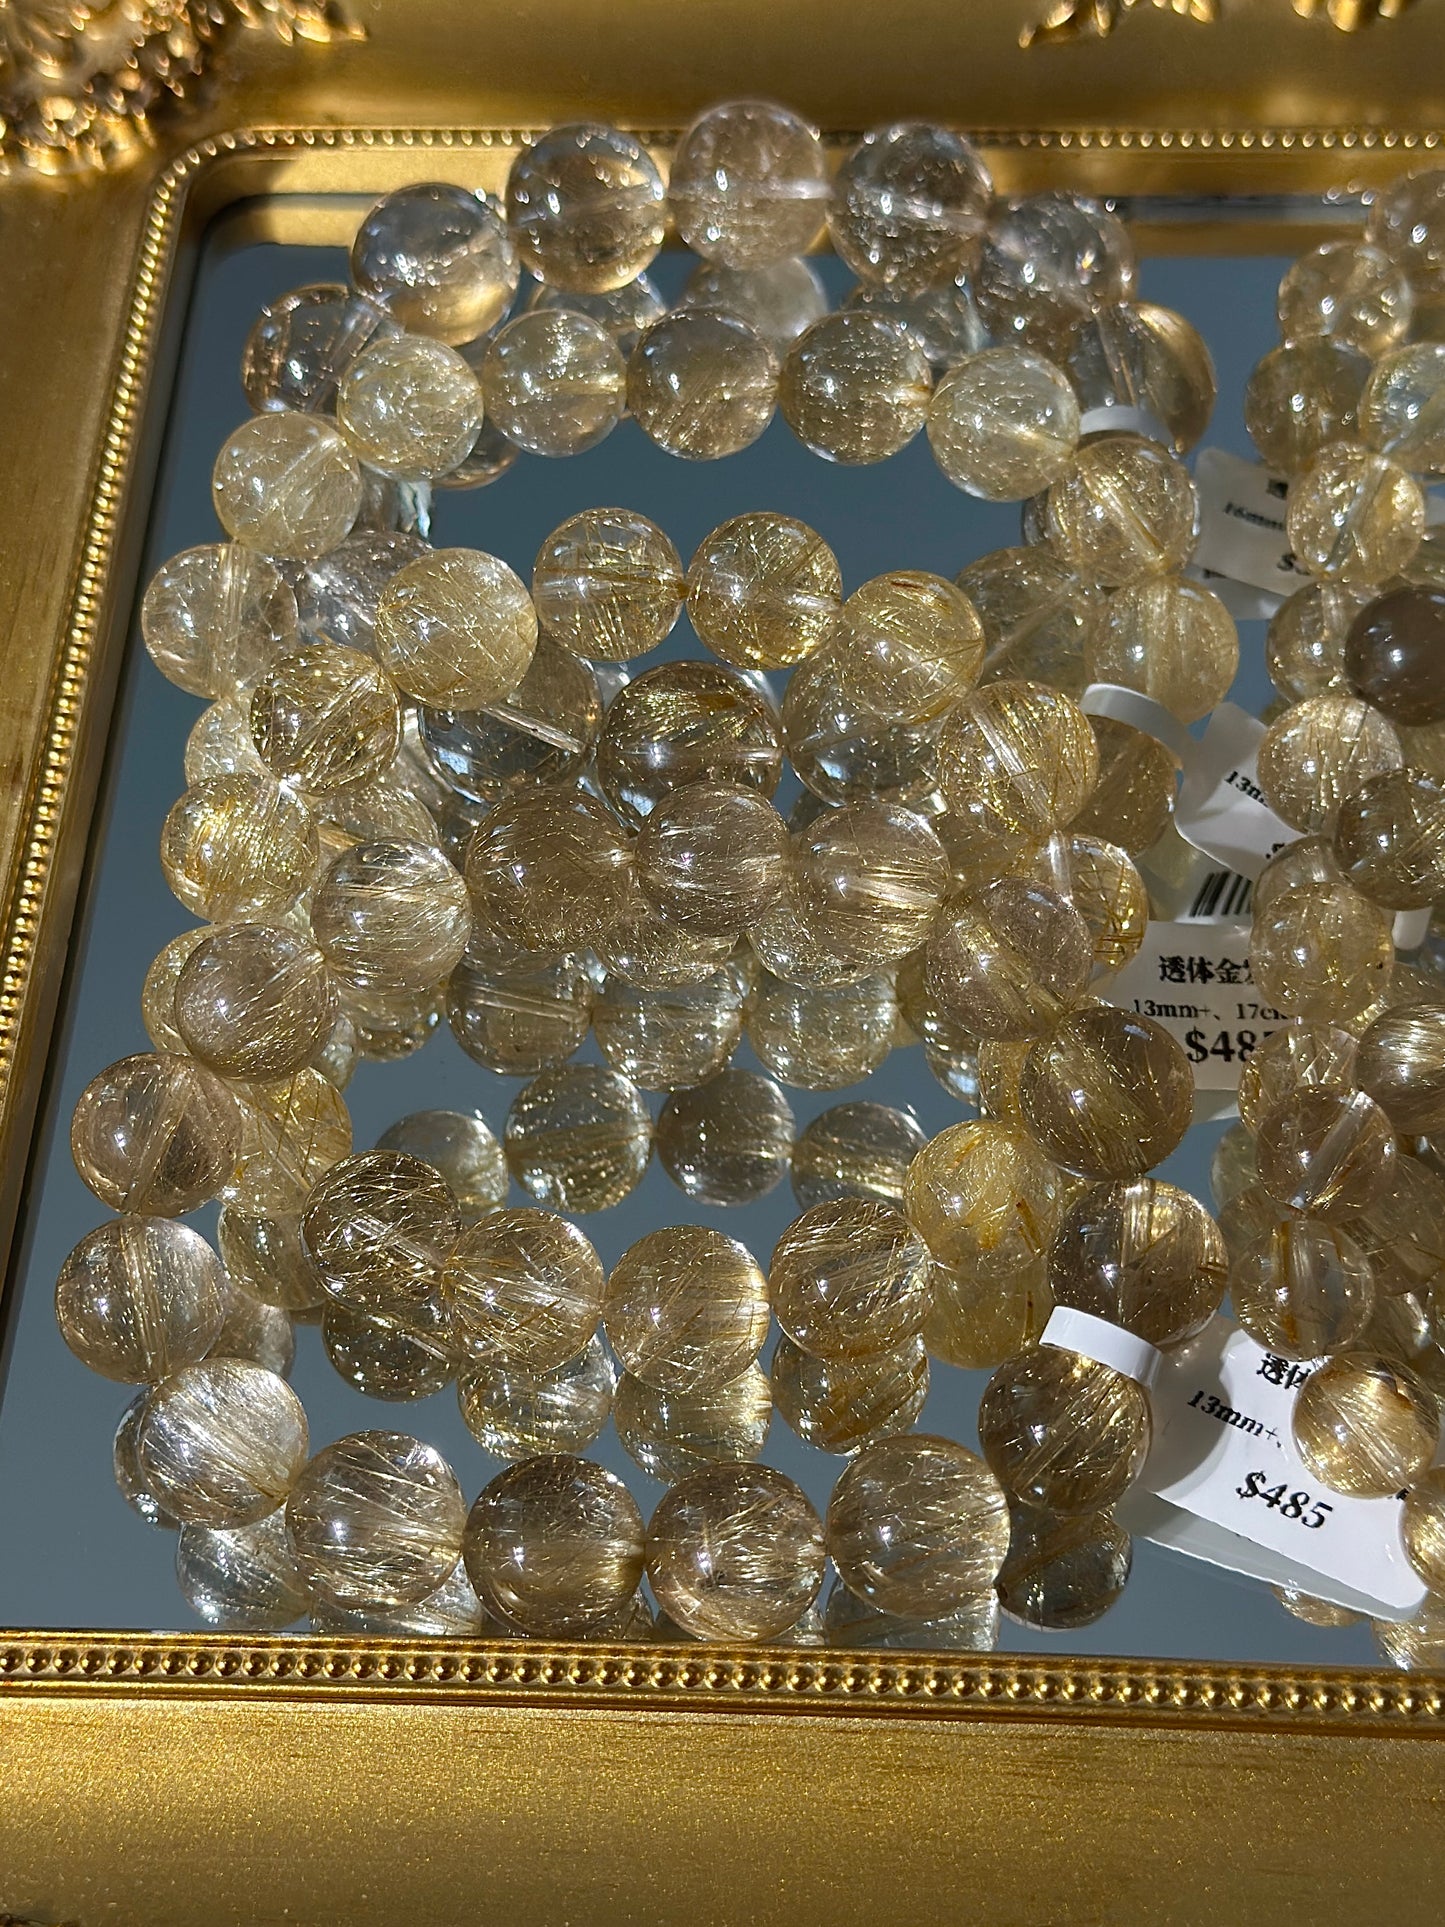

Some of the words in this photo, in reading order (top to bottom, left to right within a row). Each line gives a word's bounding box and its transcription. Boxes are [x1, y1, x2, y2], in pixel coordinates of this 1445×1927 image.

[1158, 955, 1255, 985] 透体金
[1185, 1025, 1275, 1064] $48
[1235, 1470, 1334, 1529] $485
